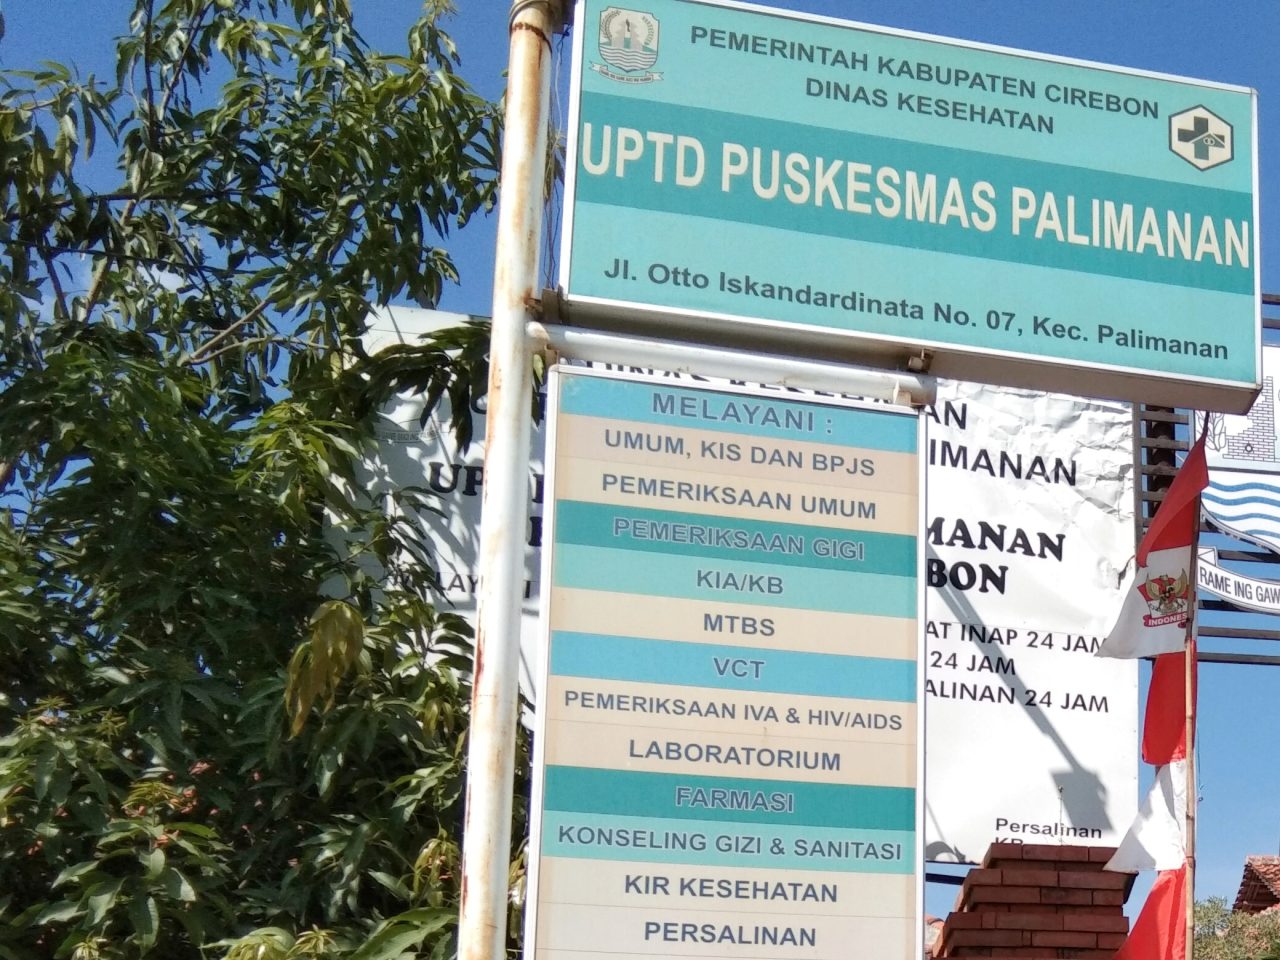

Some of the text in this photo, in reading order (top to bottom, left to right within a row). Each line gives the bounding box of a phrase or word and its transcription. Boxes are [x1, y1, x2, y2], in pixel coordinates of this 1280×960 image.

[690, 25, 1159, 120] PEMERINTAH KABUPATEN CIREBON
[806, 78, 1055, 135] DINAS KESEHATAN
[582, 122, 1250, 268] UPTD PUSKESMAS PALIMANAN
[604, 258, 1229, 361] Jl. Otto Iskandardinata No. 07, Kec. Palimanan
[652, 391, 815, 433] MELAYANI
[604, 429, 875, 477] UMUM, KIS DAN BPJS
[929, 438, 1076, 486] IMANAN
[602, 473, 877, 520] PEMERIKSAAN UMUM
[613, 517, 865, 560] PEMERIKSAAN GIGI
[696, 570, 784, 595] KIA/KB
[1200, 567, 1231, 594] RAME
[1234, 581, 1252, 600] ING
[703, 613, 776, 636] MTBS
[1148, 612, 1187, 626] INDONES
[961, 624, 1018, 645] INAP
[1027, 631, 1054, 650] 24
[713, 657, 765, 679] VCT
[930, 650, 1016, 676] 24 JAM
[564, 690, 903, 731] PEMERIKSAAN IVA & HIV/AIDS
[926, 679, 1109, 713] ALINAN 24 JAM
[628, 739, 841, 771] LABORATORIUM
[675, 786, 794, 813] FARMASI
[558, 825, 901, 861] KONSELING GIZI & SANITASI
[996, 817, 1102, 839] Persalinan
[624, 874, 838, 903] KIR KESEHATAN
[644, 921, 816, 947] PERSALINAN
